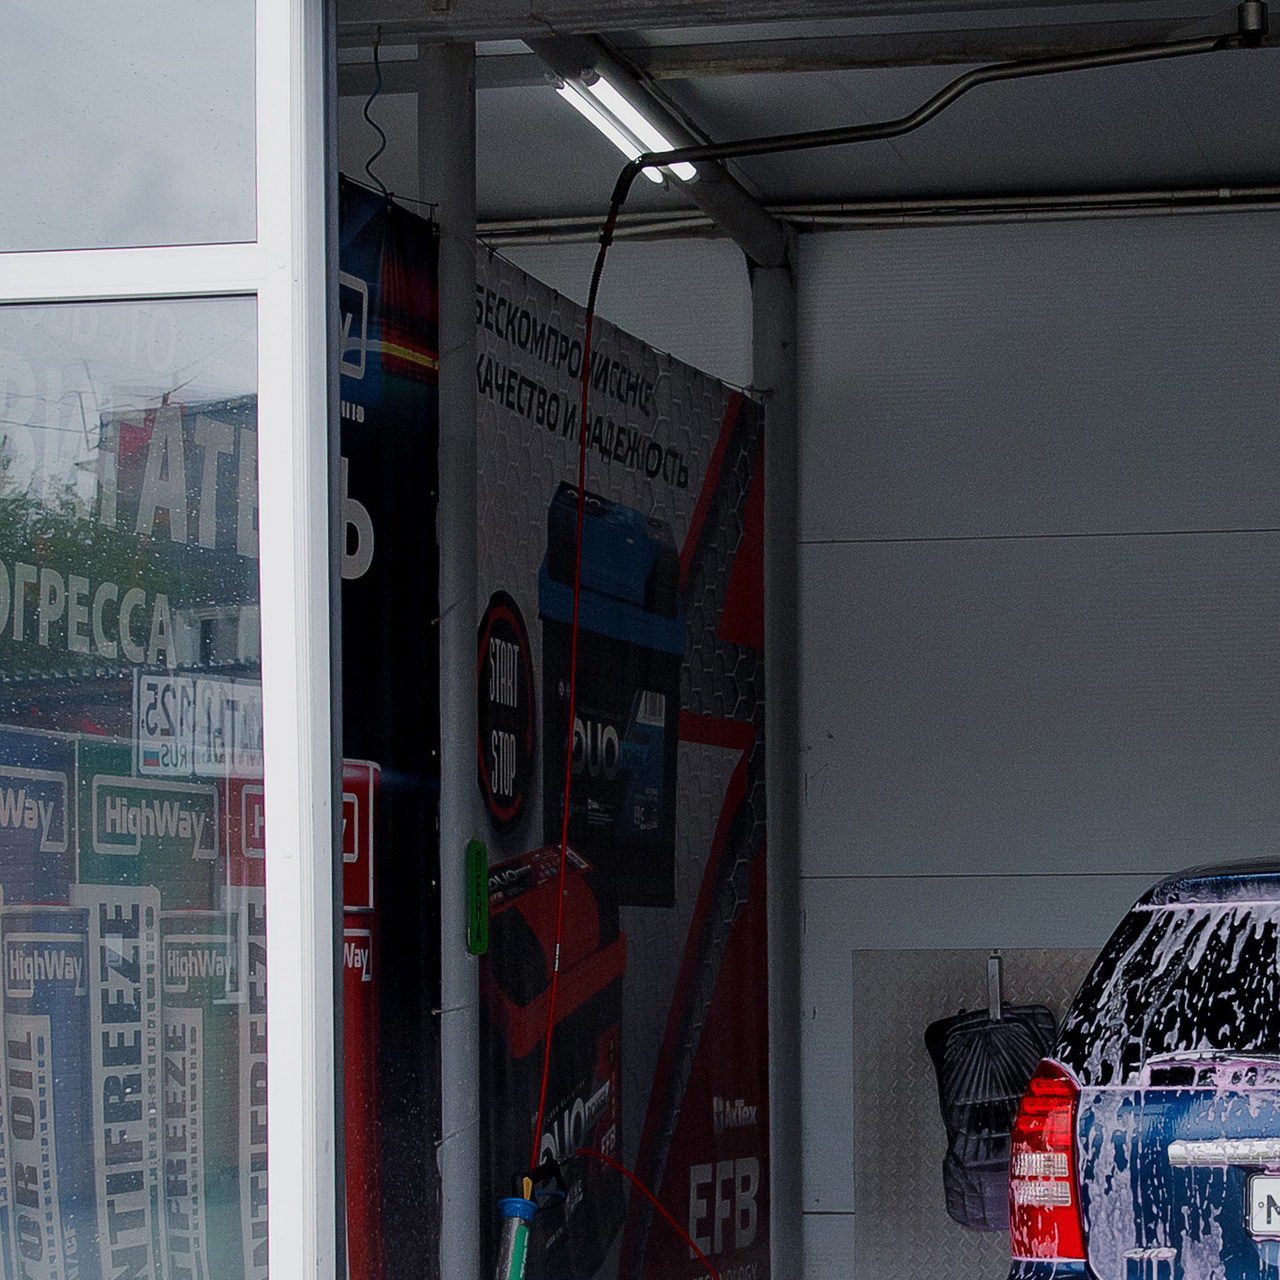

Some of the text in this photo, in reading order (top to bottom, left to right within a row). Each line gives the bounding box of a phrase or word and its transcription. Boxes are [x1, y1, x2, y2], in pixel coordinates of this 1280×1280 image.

[0, 558, 177, 670] ГРЕССА
[489, 637, 520, 709] START
[491, 729, 518, 799] STOP
[104, 795, 206, 858] HighWay
[9, 948, 84, 996] HighWay
[8, 1030, 36, 1142] OIL
[689, 1157, 759, 1259] EFB
